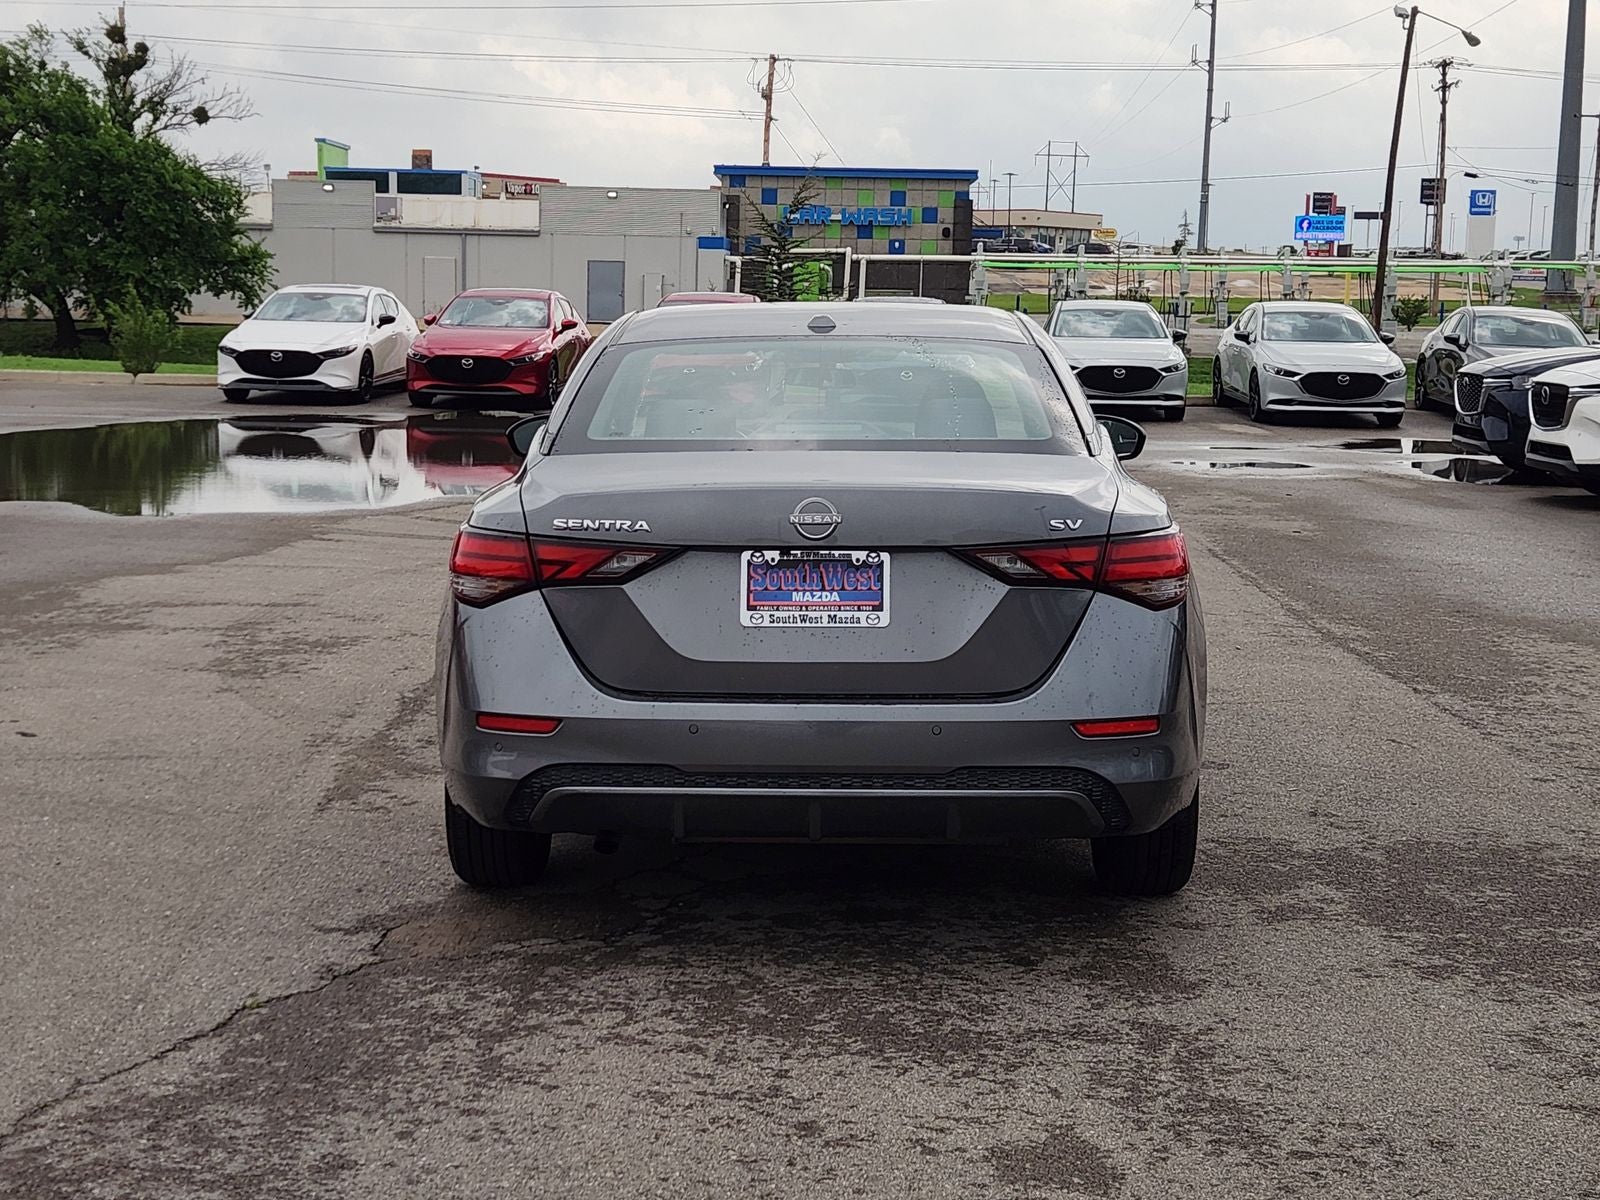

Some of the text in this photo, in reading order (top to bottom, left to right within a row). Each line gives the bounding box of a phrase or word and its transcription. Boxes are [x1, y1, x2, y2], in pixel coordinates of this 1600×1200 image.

[507, 181, 525, 196] Vapor
[841, 207, 913, 226] WASH
[790, 513, 842, 524] NISSAN
[1049, 519, 1083, 531] SV
[552, 518, 651, 533] SENTRA
[750, 562, 882, 591] SouthWest
[791, 591, 841, 602] MAZDA
[768, 613, 862, 625] SouthWest Mazda
